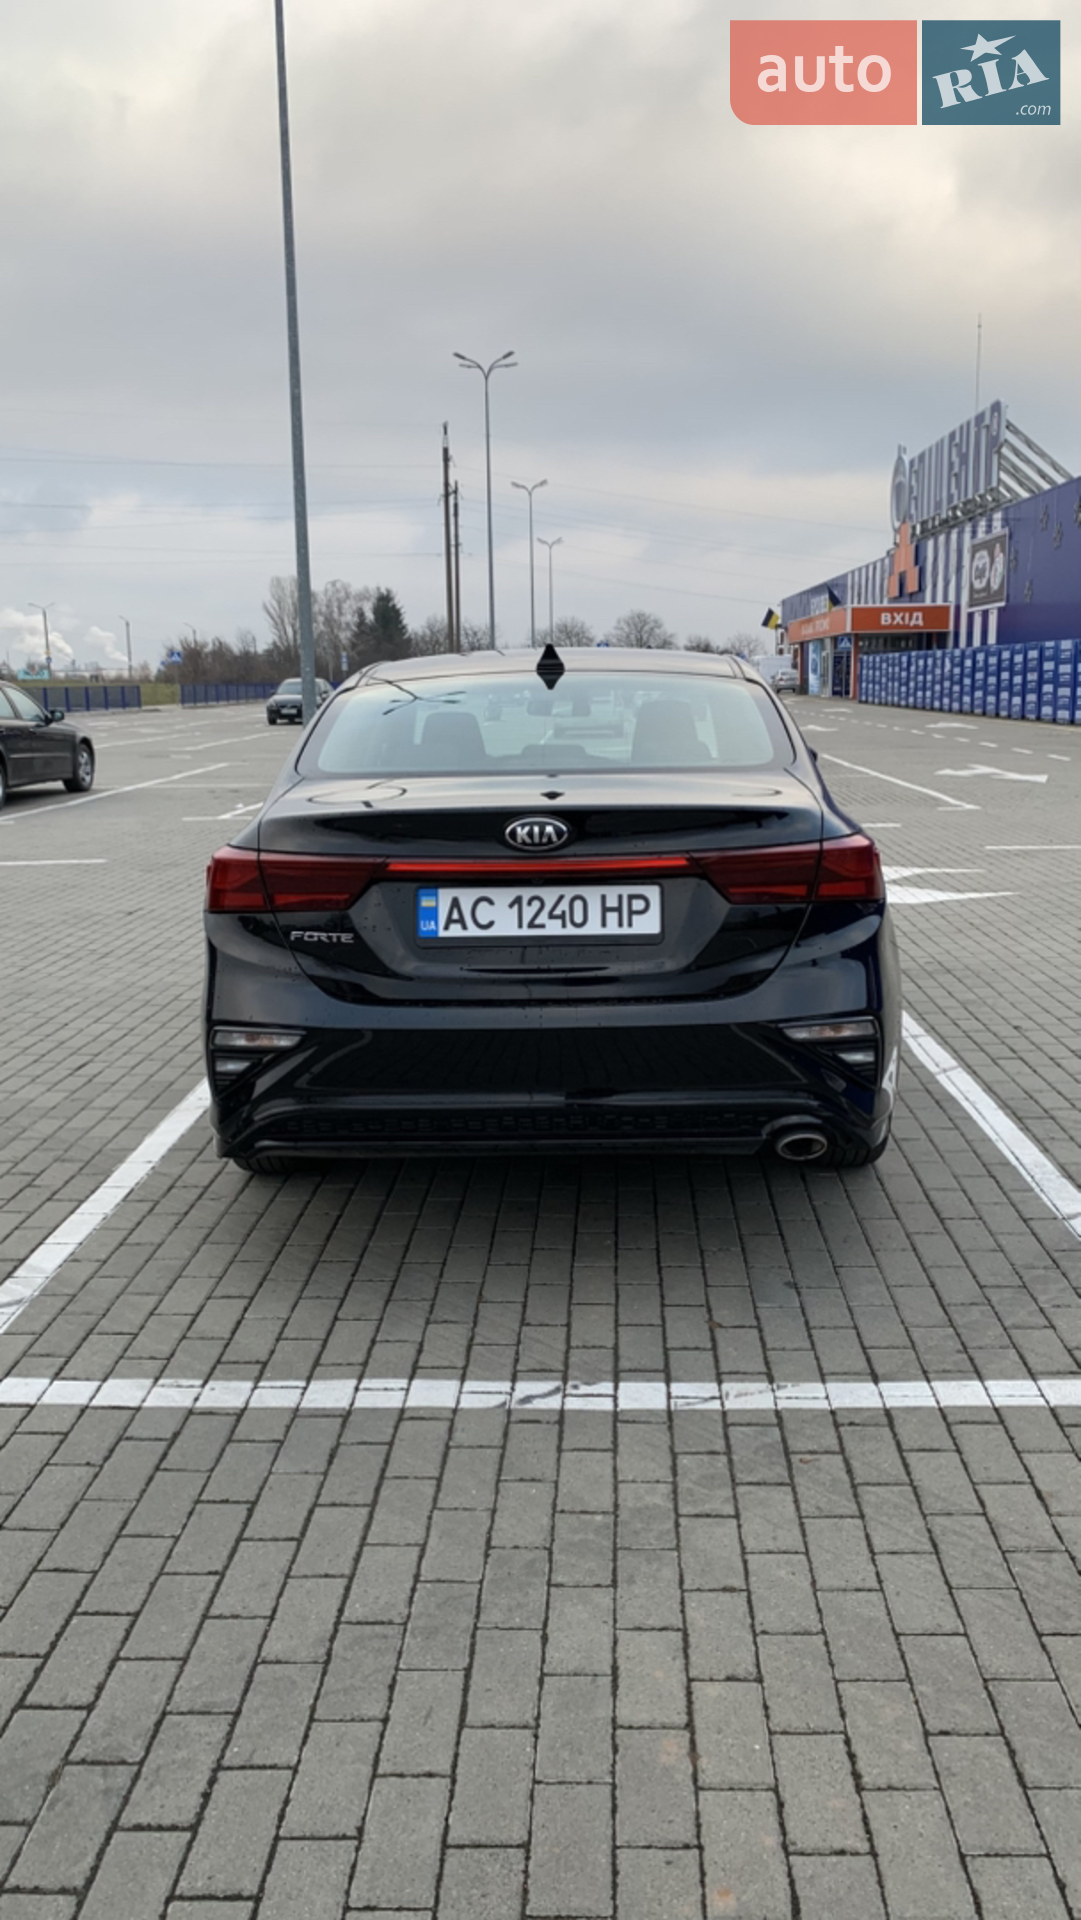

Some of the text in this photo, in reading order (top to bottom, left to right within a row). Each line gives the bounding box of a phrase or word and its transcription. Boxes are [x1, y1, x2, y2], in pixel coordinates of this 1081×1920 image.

[880, 611, 924, 627] ВХІД
[515, 824, 558, 844] KIA
[443, 893, 651, 931] AC 1240 HP
[420, 920, 437, 932] UA
[290, 931, 354, 943] FORTE
